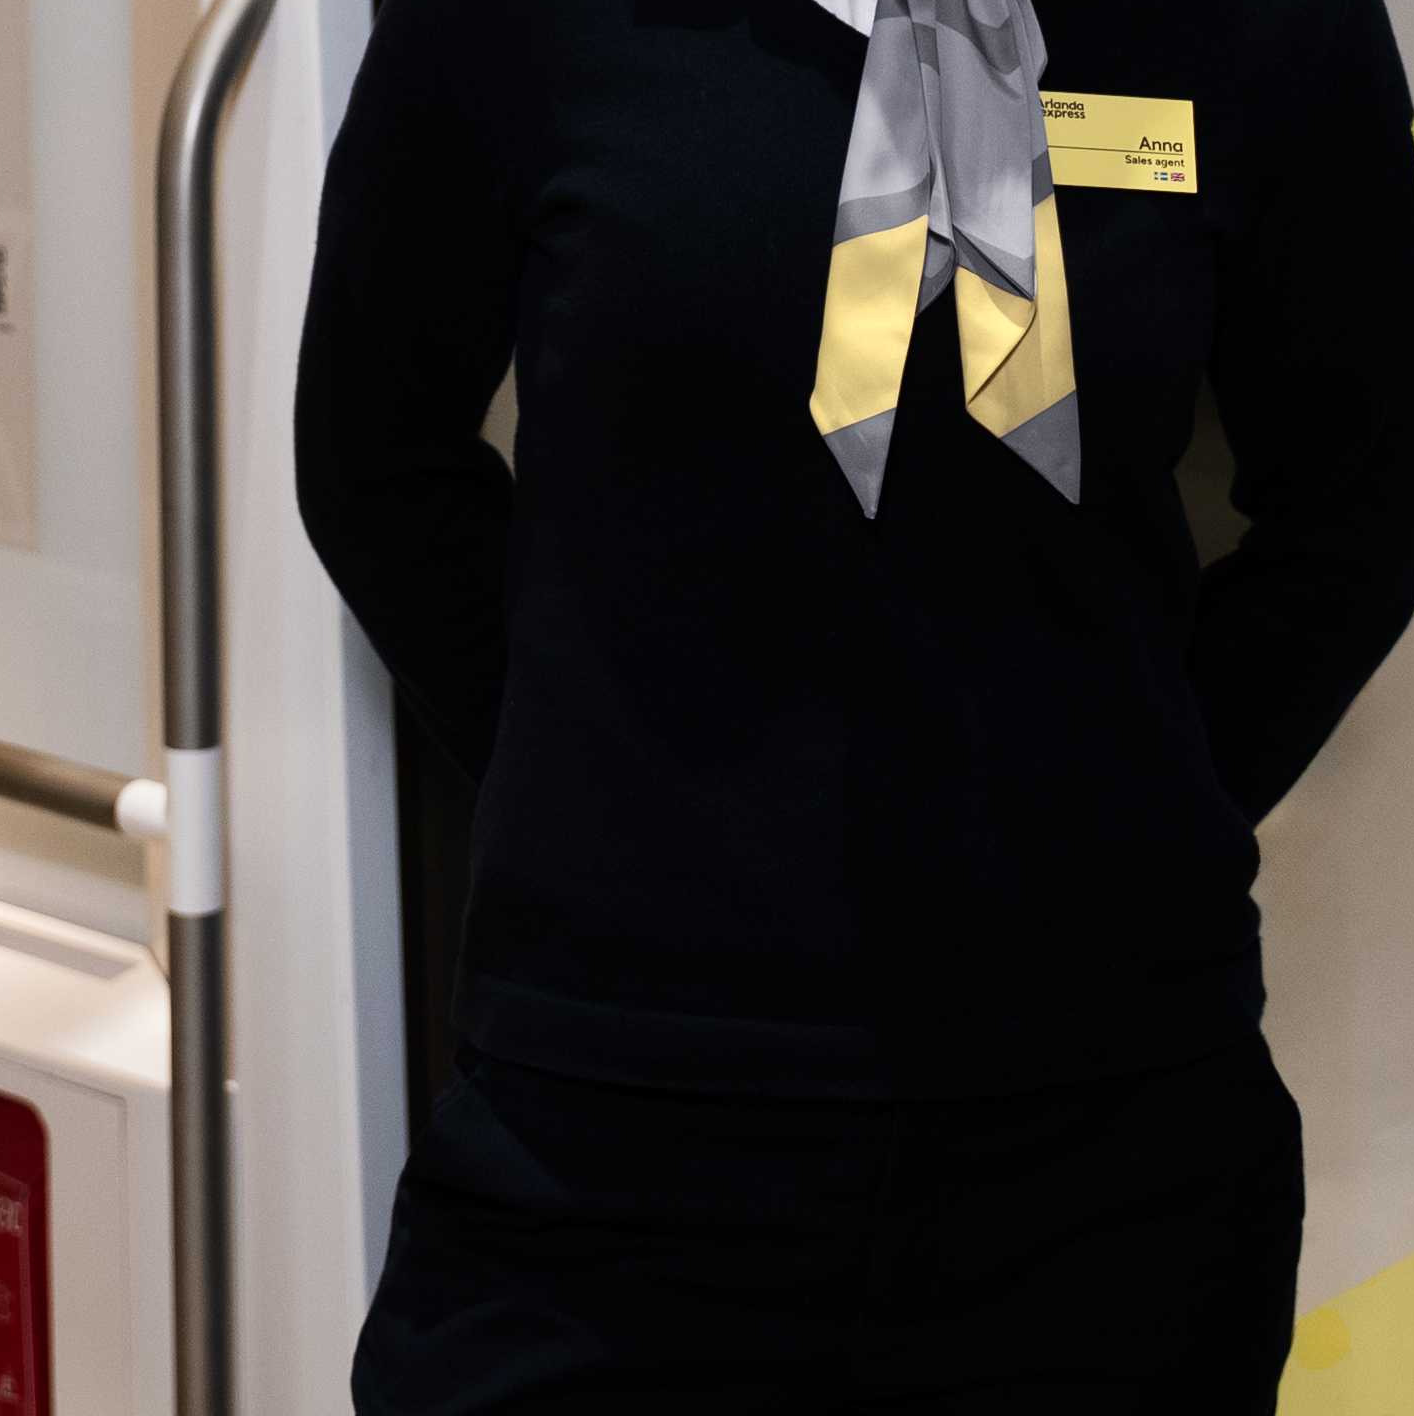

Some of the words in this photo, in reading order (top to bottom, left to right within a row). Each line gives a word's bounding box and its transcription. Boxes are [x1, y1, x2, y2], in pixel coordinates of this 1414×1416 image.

[1042, 109, 1086, 119] express
[1139, 136, 1183, 152] Anna
[1125, 155, 1152, 165] Sales
[1155, 159, 1185, 168] agent
